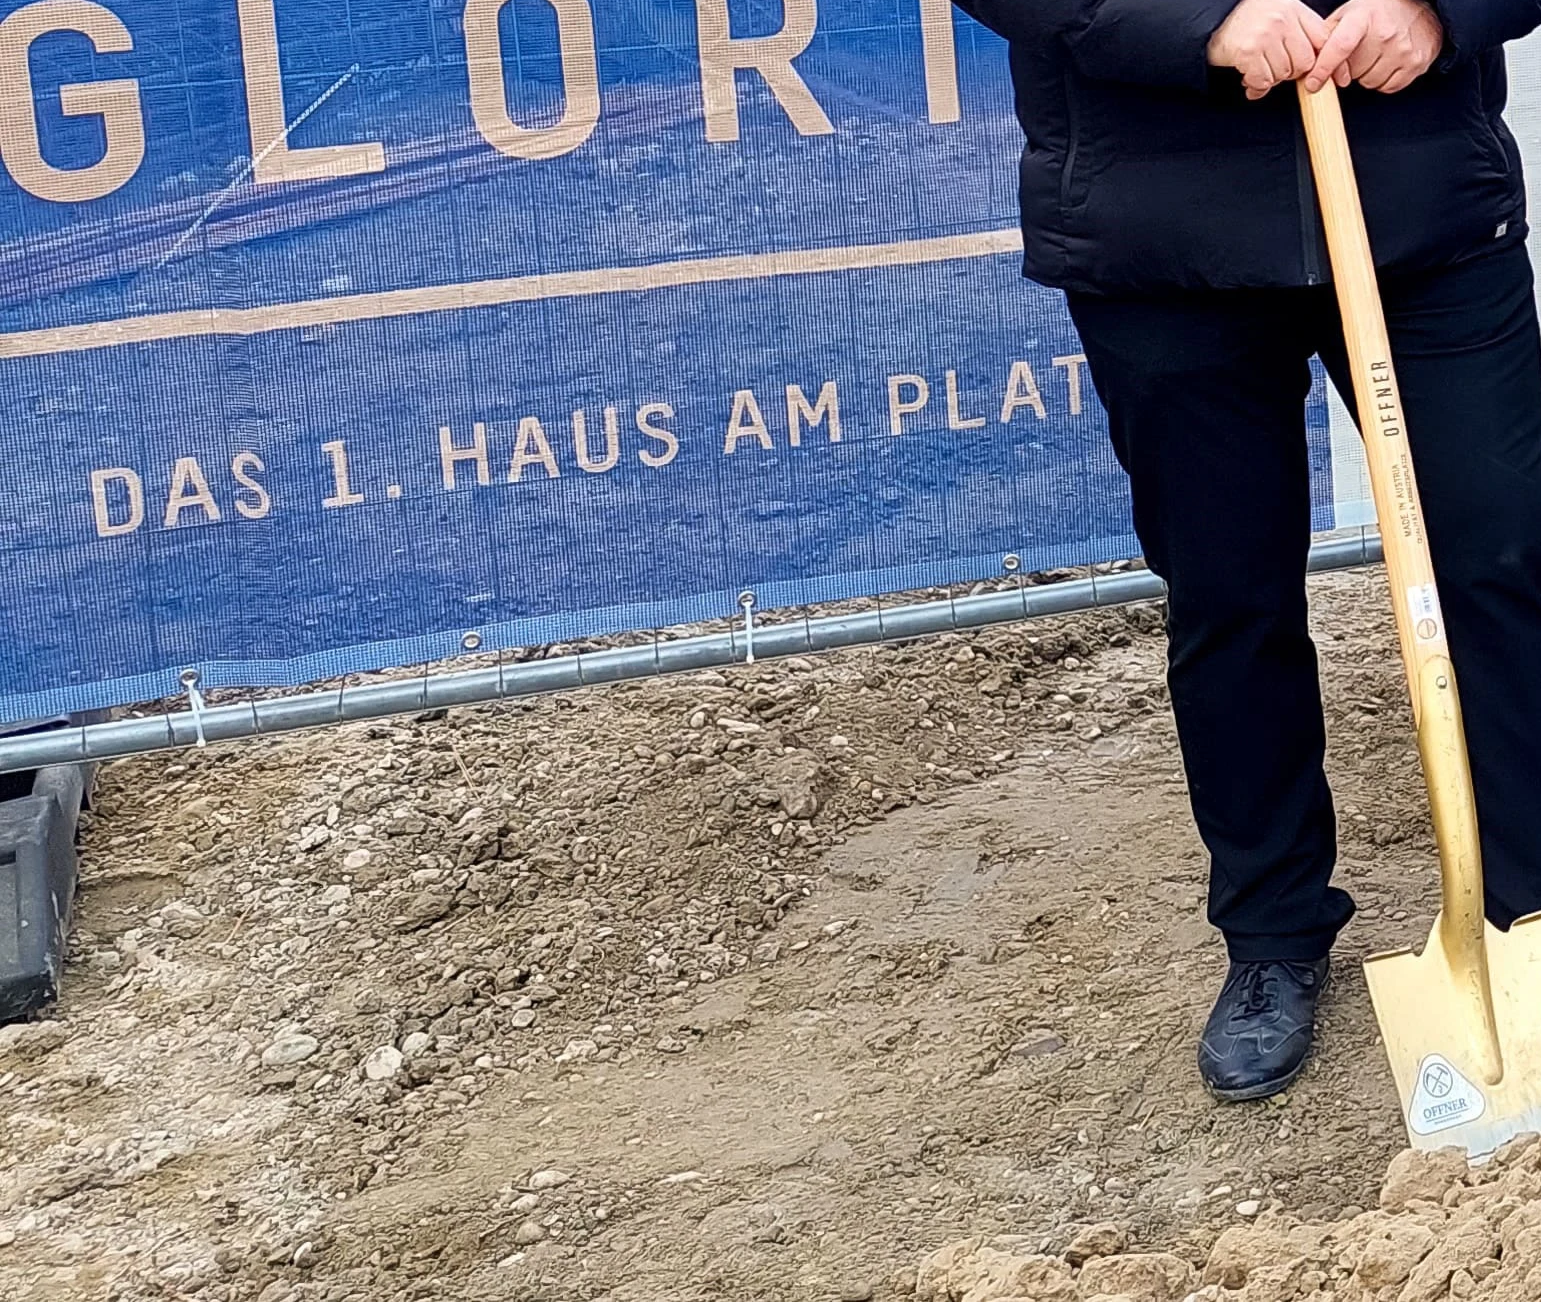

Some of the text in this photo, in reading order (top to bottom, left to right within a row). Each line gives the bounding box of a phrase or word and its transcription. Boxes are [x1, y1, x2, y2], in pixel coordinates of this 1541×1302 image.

[1371, 360, 1400, 438] OFFNER
[90, 353, 1088, 537] DAS 1. HAUS AM PLAT
[1392, 464, 1413, 538] MADE IN AUSTRIA
[1423, 1098, 1468, 1120] OFFNER
